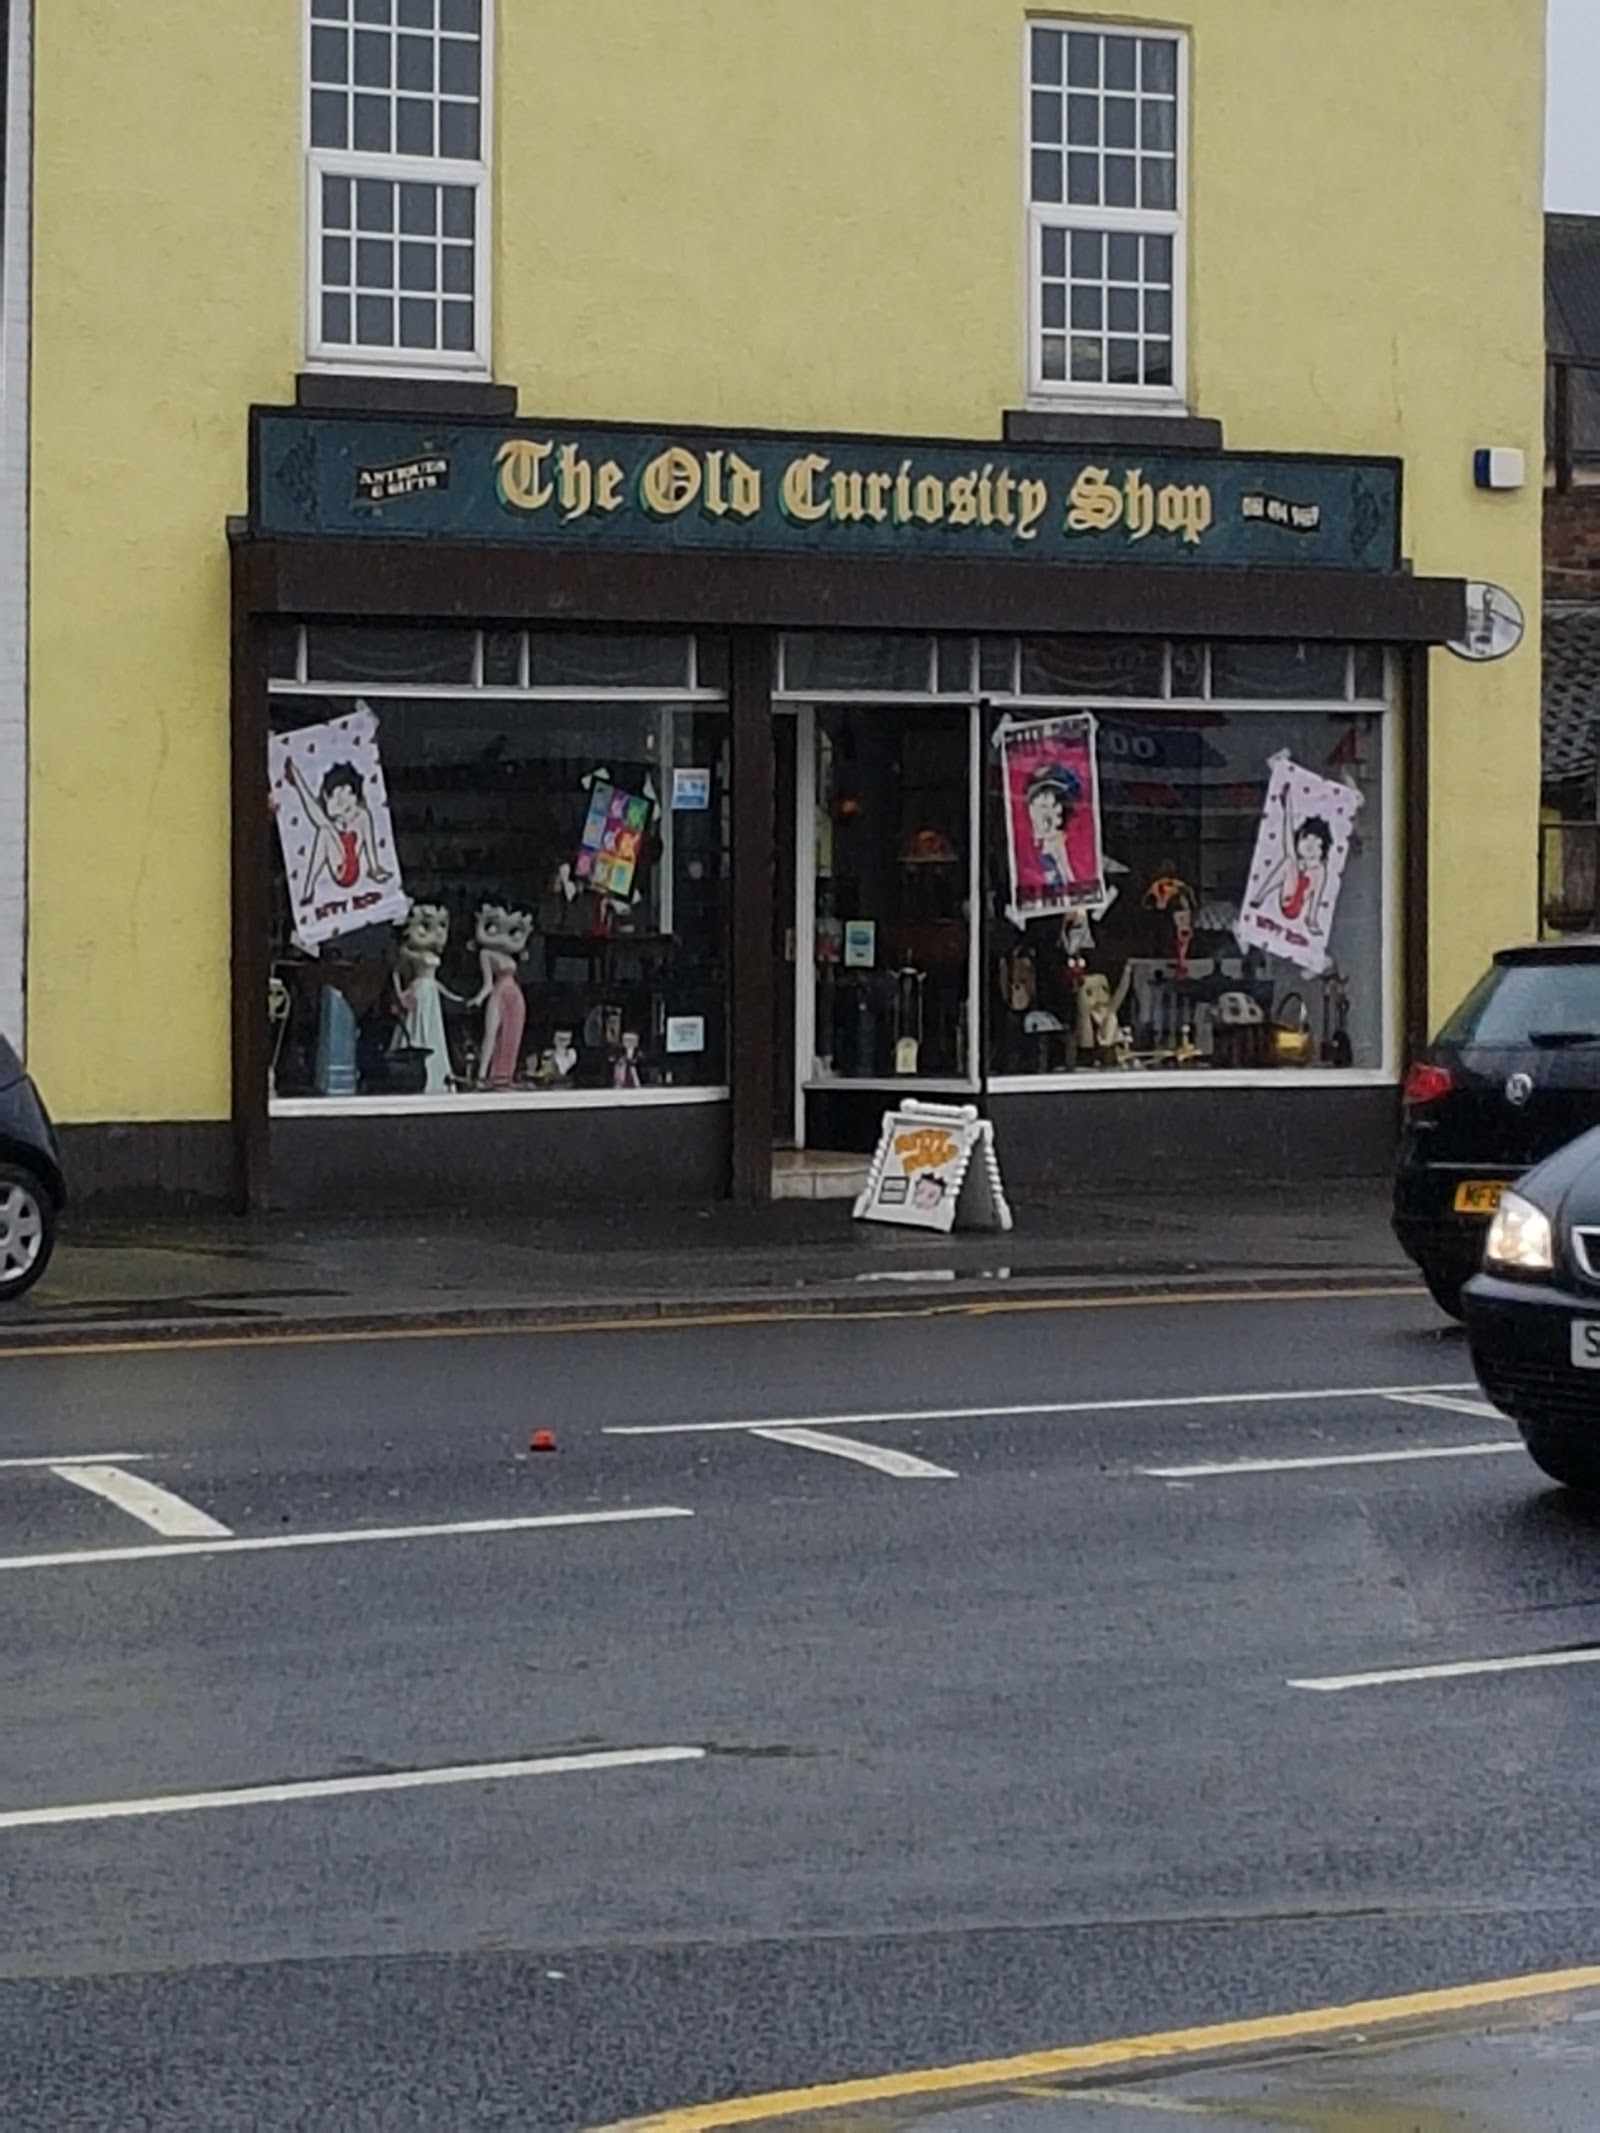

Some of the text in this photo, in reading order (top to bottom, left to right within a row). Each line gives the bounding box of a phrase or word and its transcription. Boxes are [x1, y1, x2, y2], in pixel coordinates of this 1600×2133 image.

[493, 439, 1212, 544] The Old Curiosity Shop
